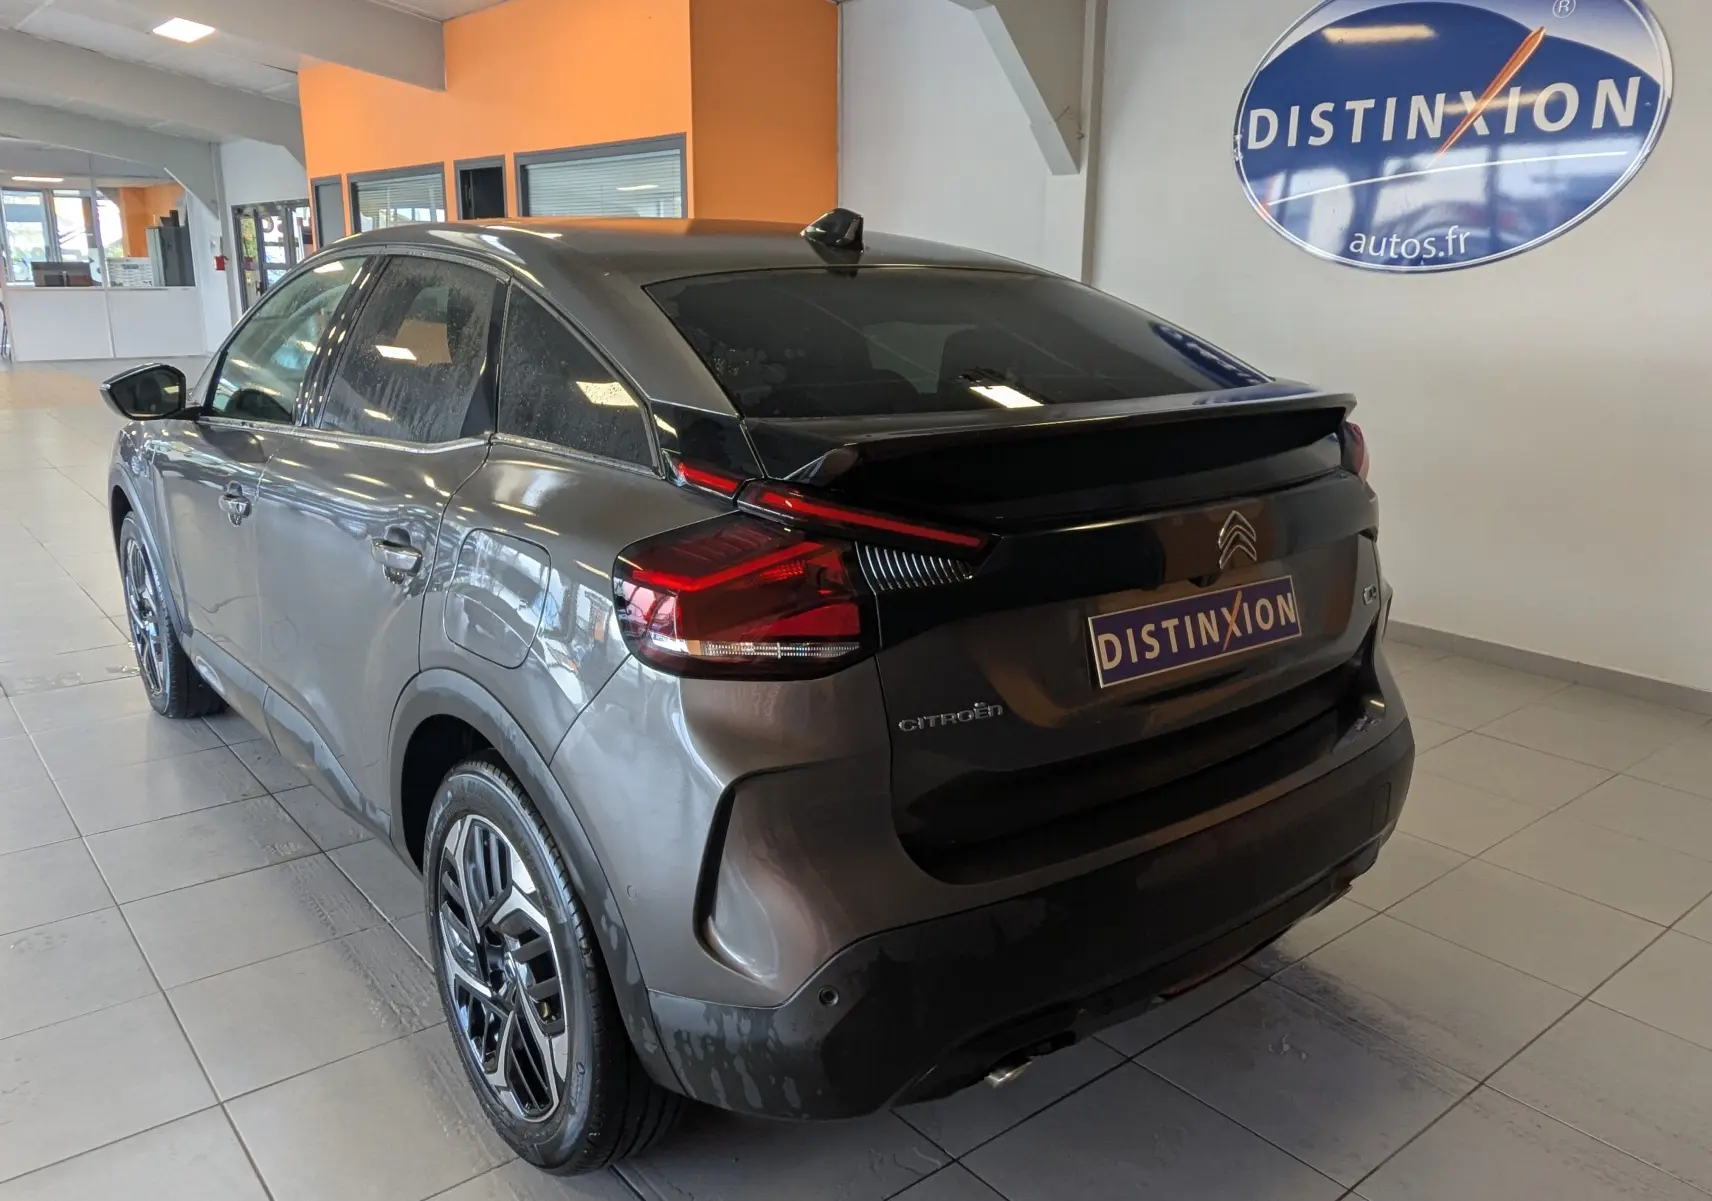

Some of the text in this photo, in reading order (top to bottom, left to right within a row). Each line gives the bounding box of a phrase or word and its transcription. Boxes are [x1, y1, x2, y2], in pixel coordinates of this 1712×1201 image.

[1246, 75, 1642, 152] DISTINXION
[1348, 224, 1472, 260] autos.fr
[1096, 590, 1297, 672] DISTINXION
